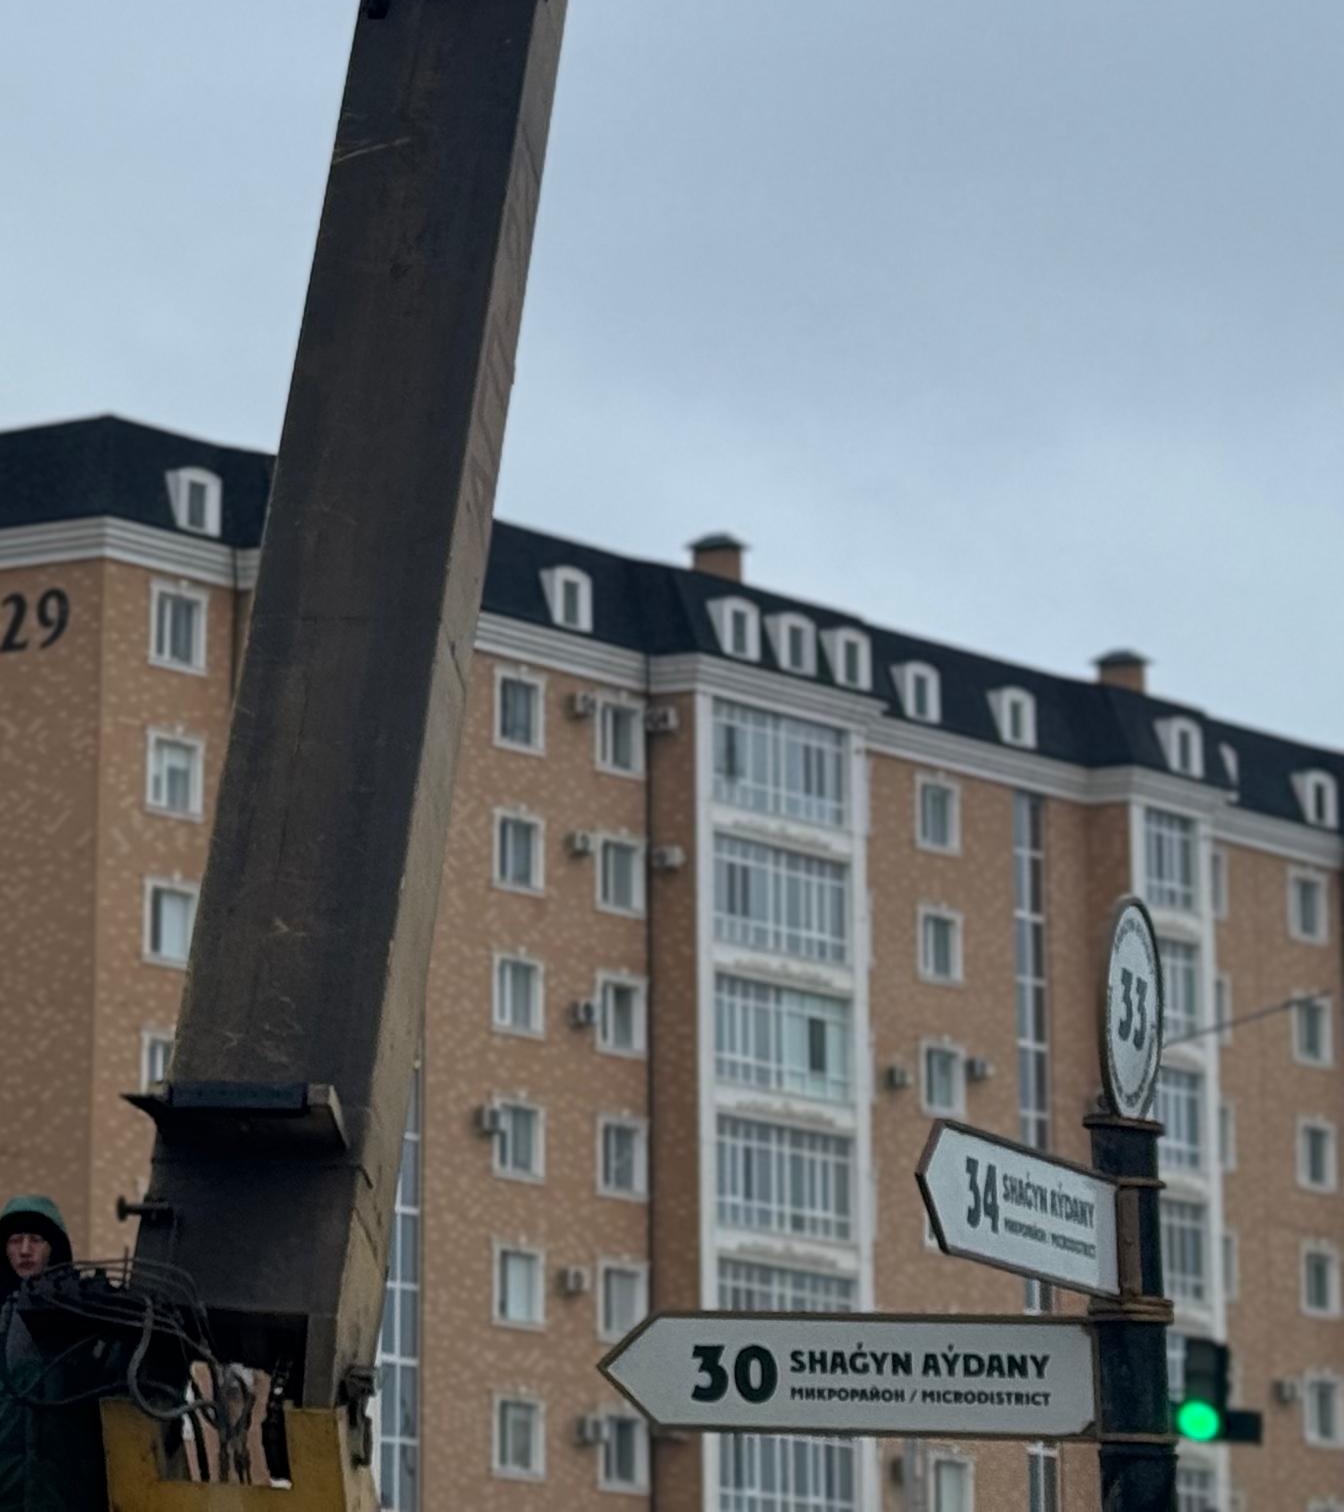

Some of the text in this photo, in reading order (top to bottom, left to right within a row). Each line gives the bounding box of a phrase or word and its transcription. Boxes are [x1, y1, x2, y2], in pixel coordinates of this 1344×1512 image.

[0, 588, 69, 654] 29
[1118, 967, 1147, 1051] 33
[966, 1156, 999, 1234] 34
[691, 1344, 778, 1404] 30
[790, 1385, 905, 1403] МИКРОРАЙОН
[921, 1390, 1051, 1407] MICRODISTRICT
